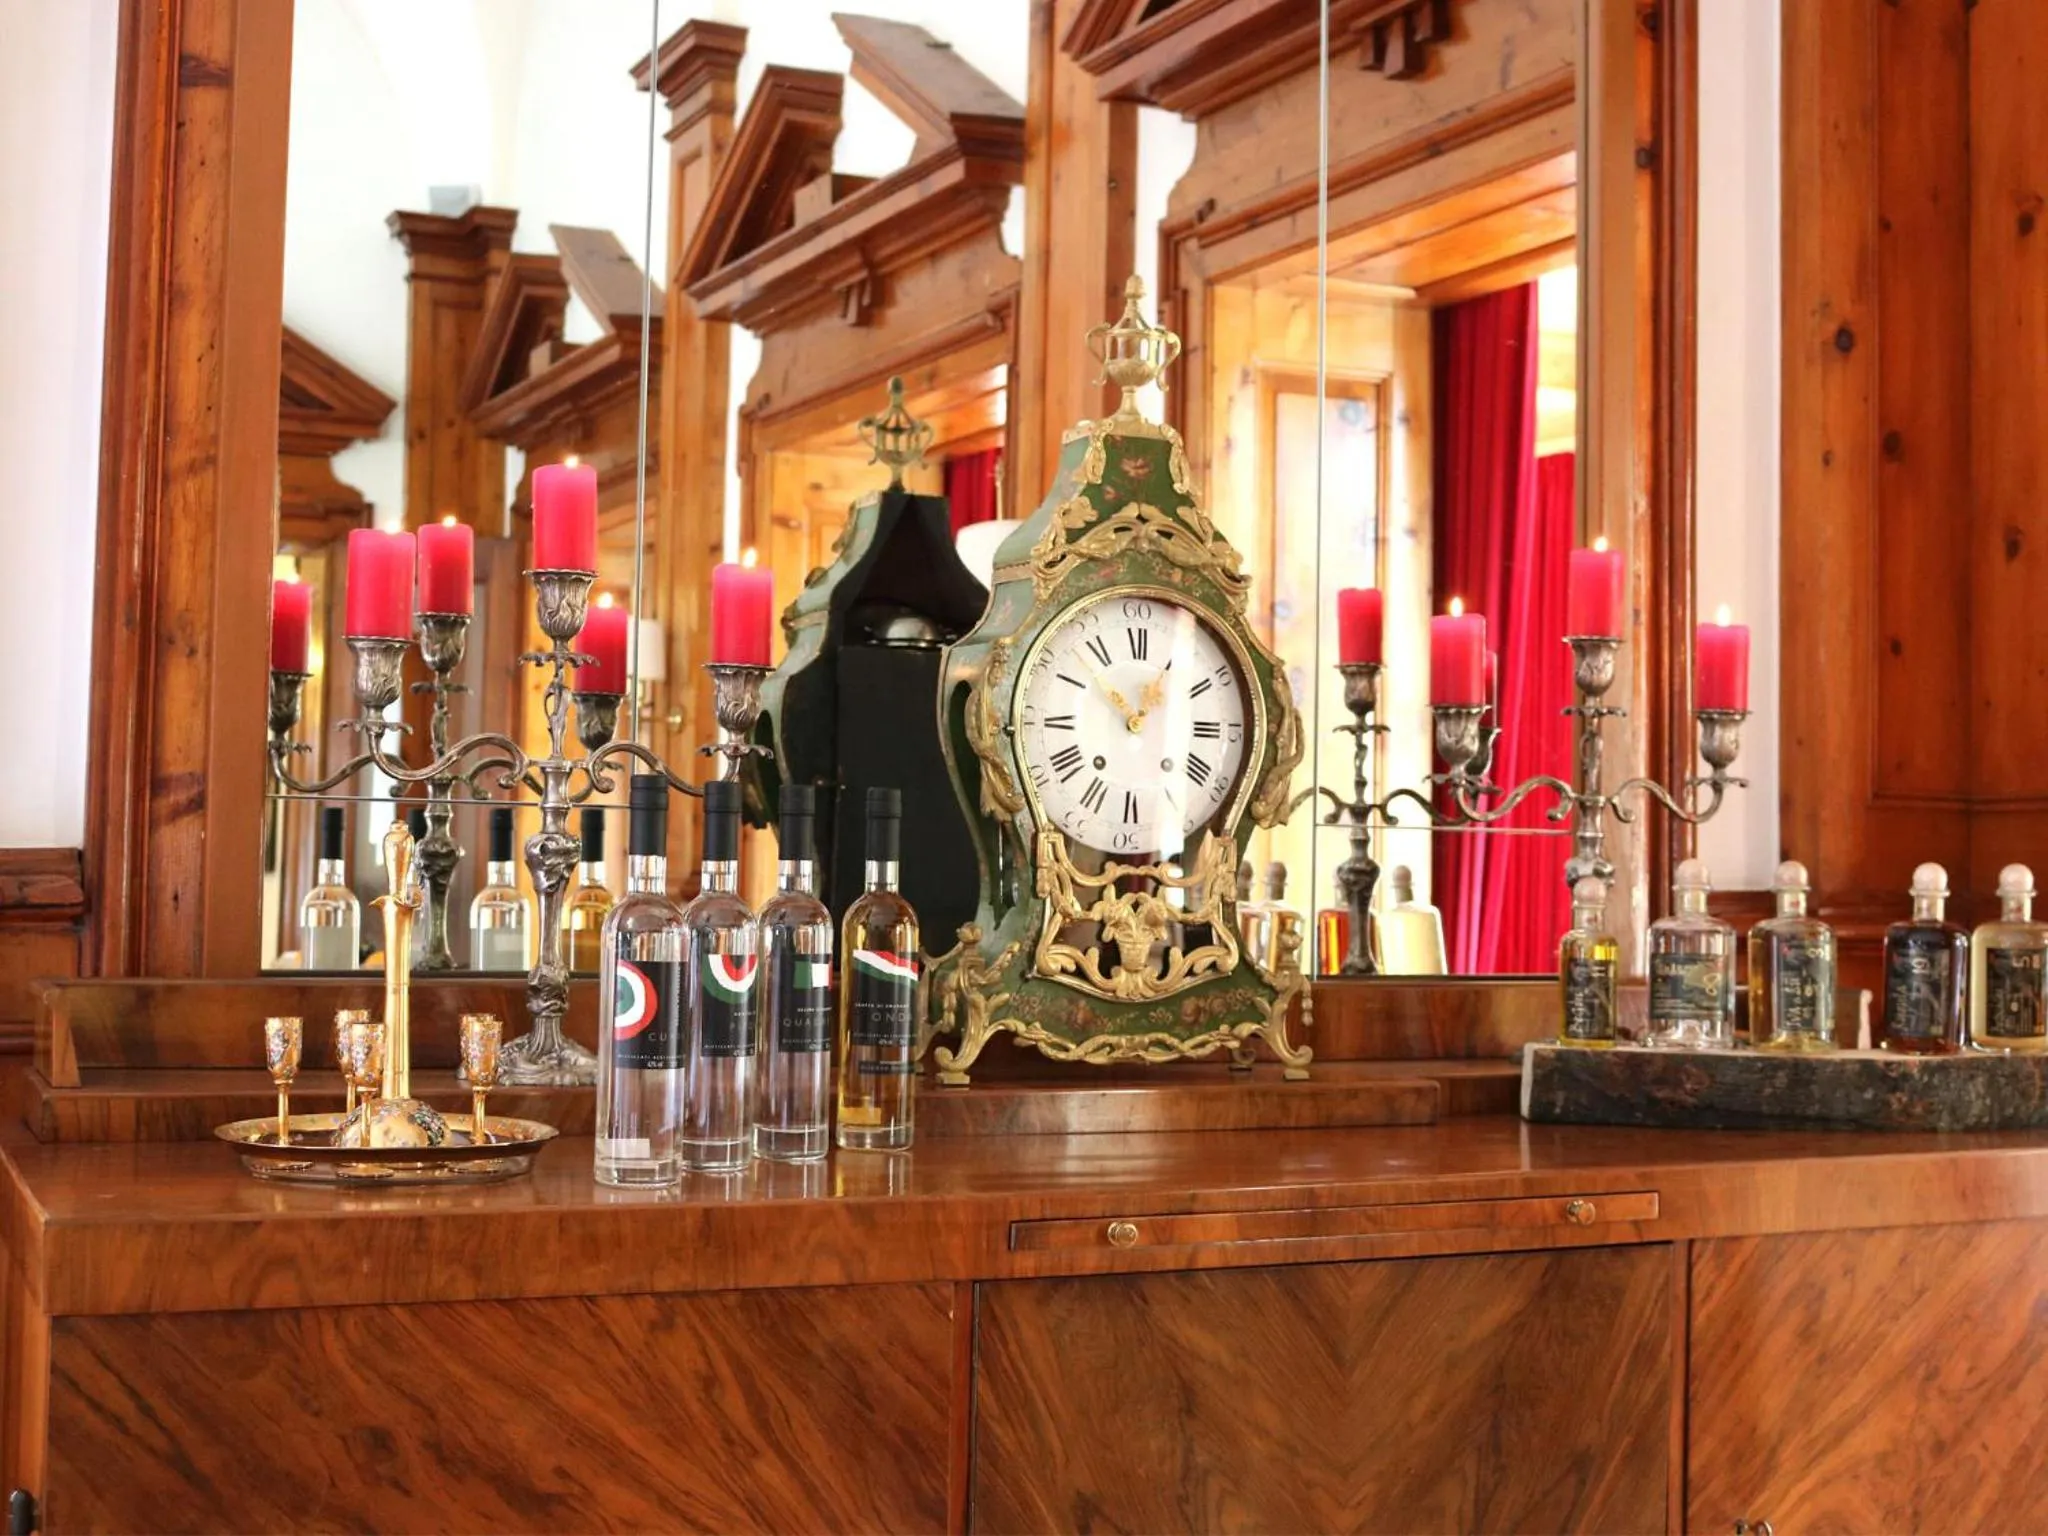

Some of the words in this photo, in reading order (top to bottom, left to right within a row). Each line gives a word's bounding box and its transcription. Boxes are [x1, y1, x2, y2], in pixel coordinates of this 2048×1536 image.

[1122, 600, 1151, 620] 60
[1214, 664, 1233, 688] 10
[1188, 677, 1213, 699] II
[1193, 720, 1221, 739] III
